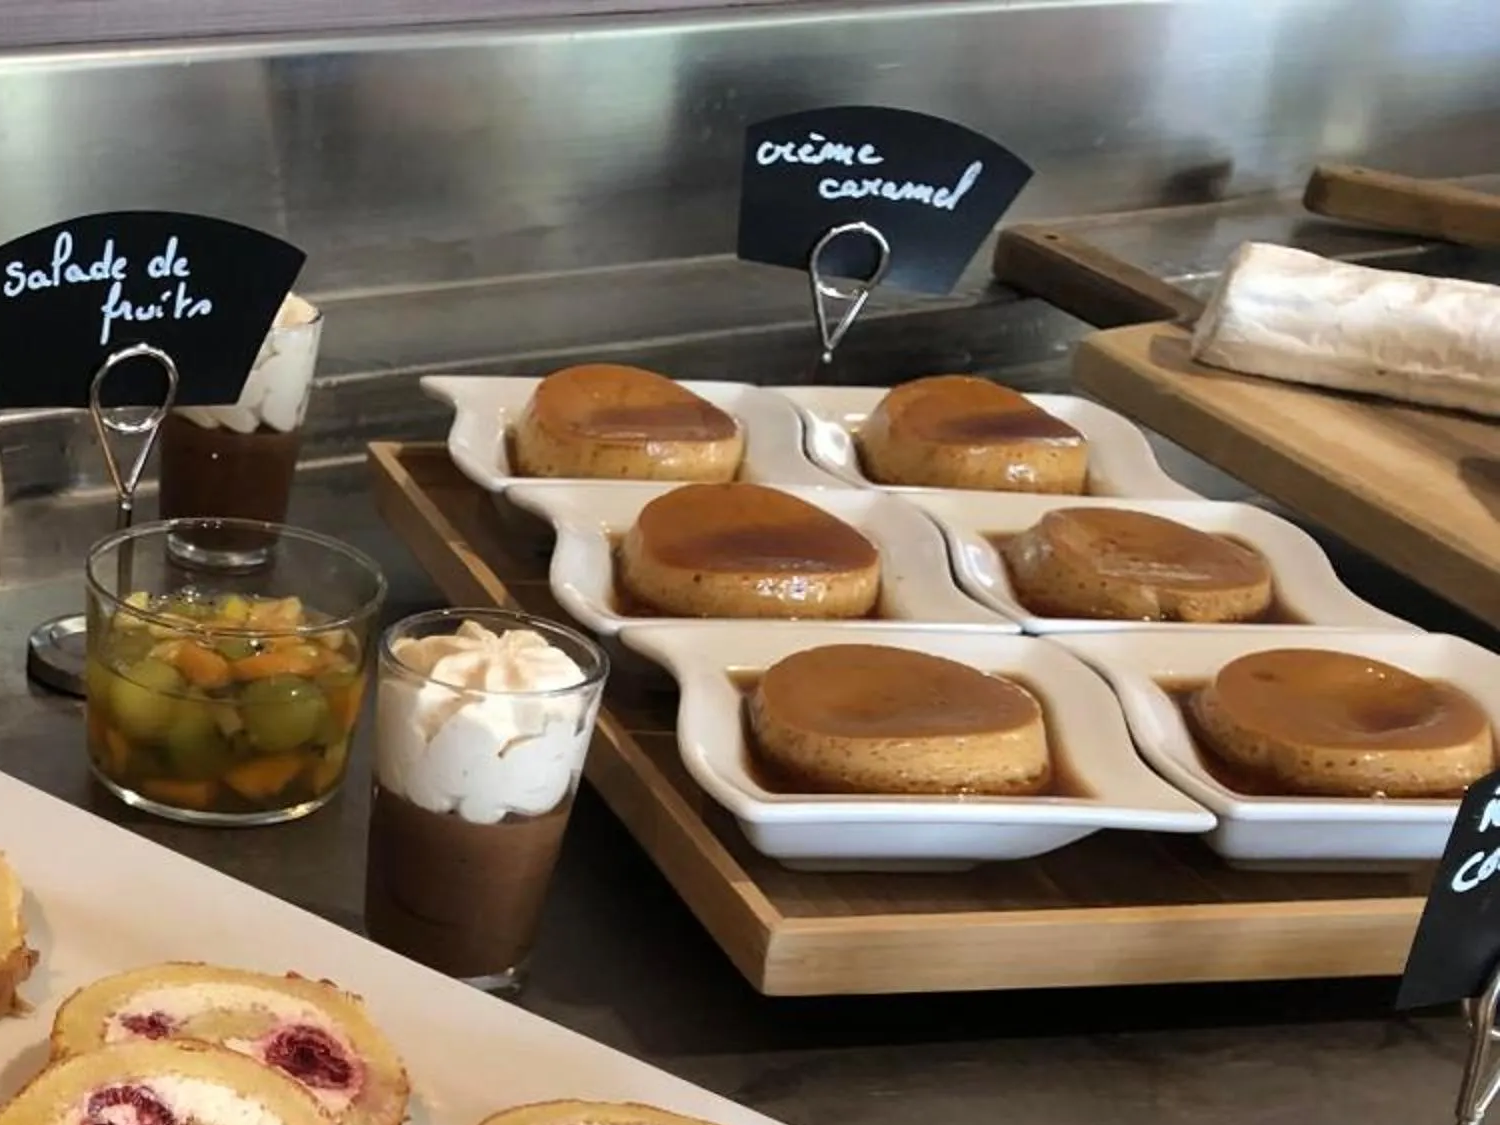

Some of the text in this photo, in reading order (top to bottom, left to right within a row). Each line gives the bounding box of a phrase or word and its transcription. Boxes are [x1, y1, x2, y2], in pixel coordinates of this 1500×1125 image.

[756, 132, 885, 165] crème
[818, 160, 983, 211] caramel
[147, 236, 190, 279] de
[100, 281, 213, 345] fruits
